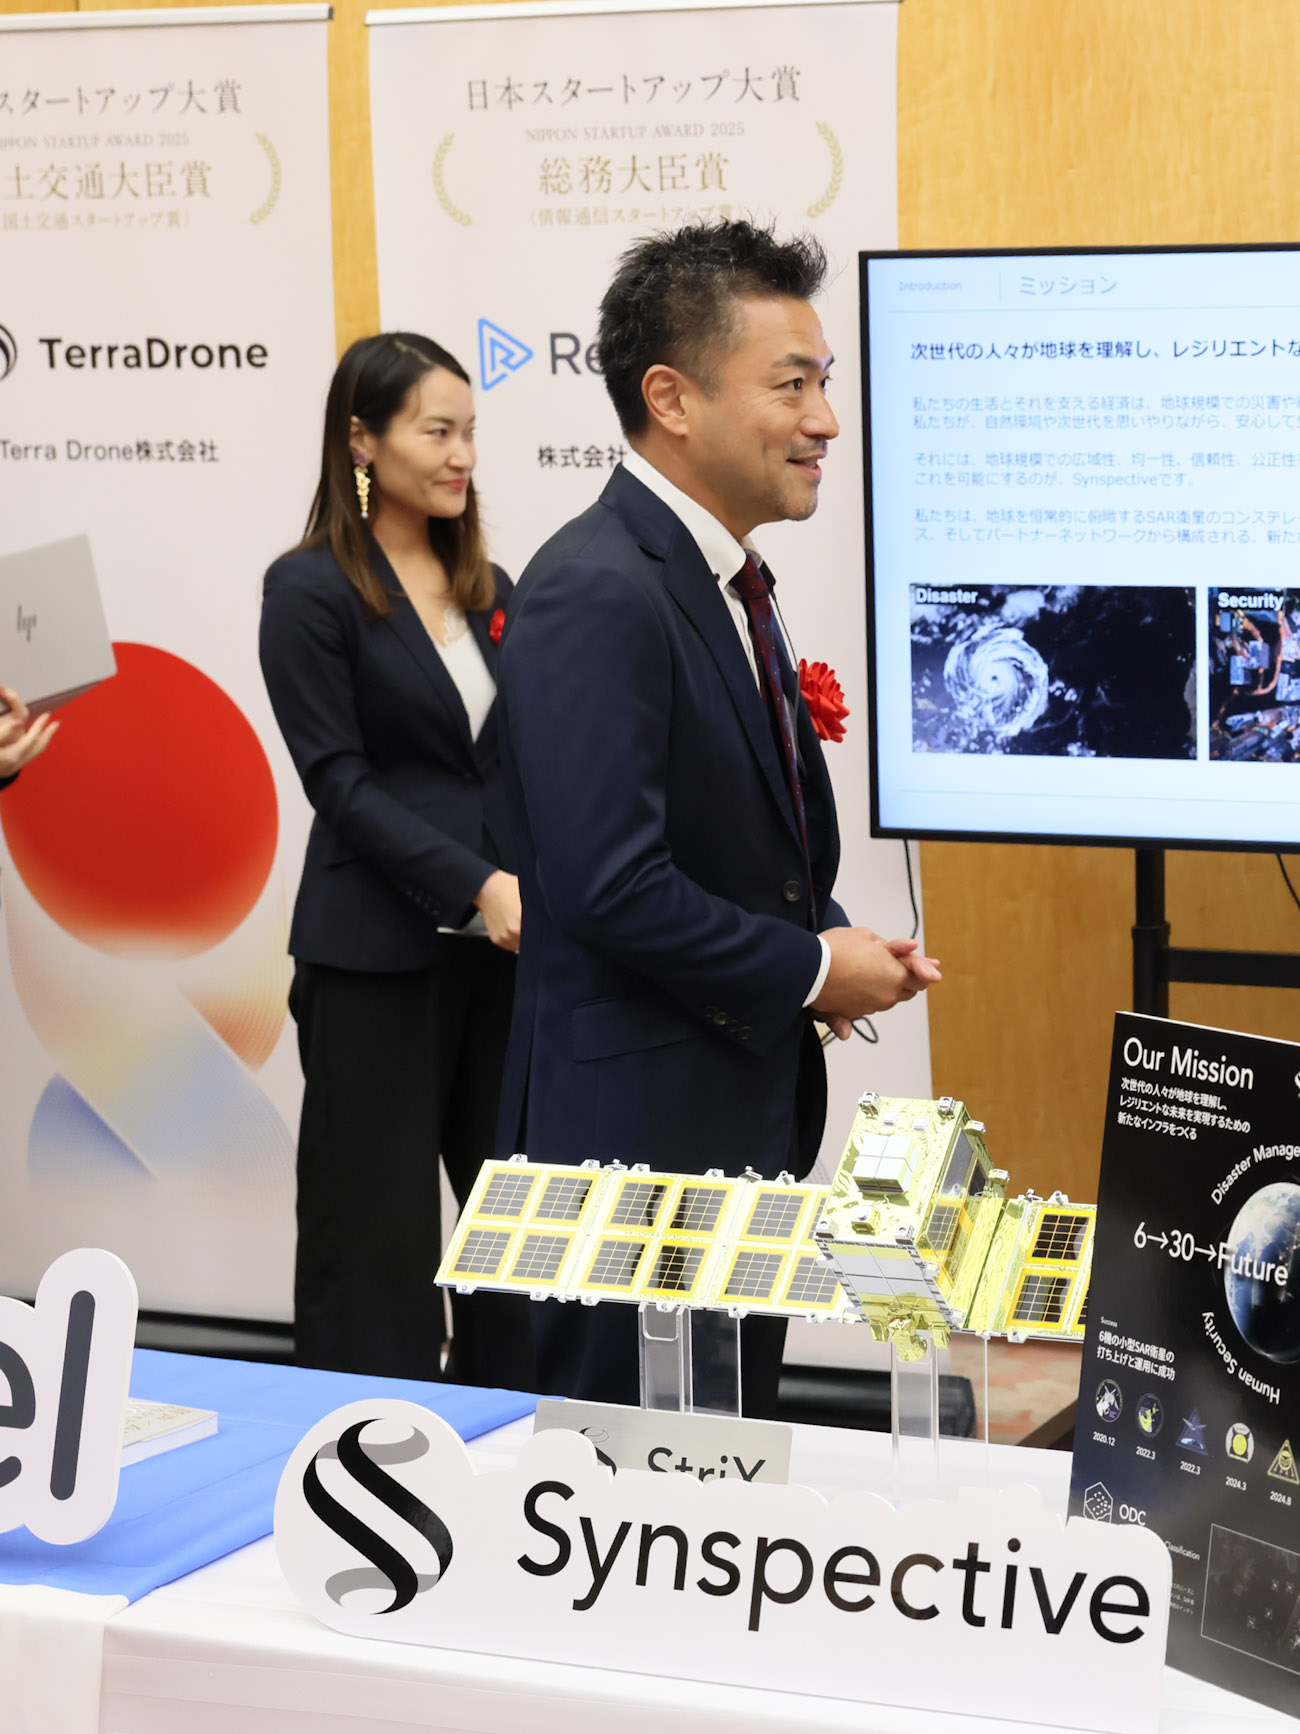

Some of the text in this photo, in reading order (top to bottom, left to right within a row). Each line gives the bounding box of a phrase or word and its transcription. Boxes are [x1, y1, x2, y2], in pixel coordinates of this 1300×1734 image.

[467, 65, 801, 111] 日本スタートアップ大賞
[526, 121, 745, 142] NIPPON STARTUP AWARD 2025
[5, 160, 212, 200] 土交通大臣賞
[539, 151, 729, 195] 総務大臣賞
[899, 281, 962, 291] Introduction
[1019, 276, 1118, 295] ミッション
[39, 337, 268, 369] TerraDrone
[0, 440, 219, 462] Terra Drone株式会社
[538, 444, 628, 469] 株式会社
[915, 588, 978, 605] Disaster
[1218, 592, 1284, 611] Security
[1123, 1037, 1254, 1090] Our Mission
[1120, 1077, 1228, 1111] 次世代の人々が地球を理解し、
[1117, 1111, 1197, 1140] 新たなインフラをつくる
[1119, 1095, 1251, 1133] レジリエントな未来を実現するための
[1210, 1156, 1251, 1205] Disaster
[1217, 1241, 1288, 1287] Future
[1098, 1330, 1175, 1363] 6機の小型SAR衛星の
[1202, 1312, 1238, 1374] Security
[1096, 1345, 1176, 1381] 打ち上げと運用に成功
[1238, 1368, 1281, 1404] Human
[1093, 1431, 1116, 1446] 2020.12
[1136, 1446, 1156, 1460] 2022.3
[1180, 1461, 1201, 1475] 2022.3
[1225, 1476, 1247, 1491] 2024.3
[1269, 1491, 1292, 1506] 2024.8
[1119, 1504, 1147, 1526] ODC
[516, 1480, 1151, 1644] Synspective
[1164, 1541, 1200, 1560] Classification
